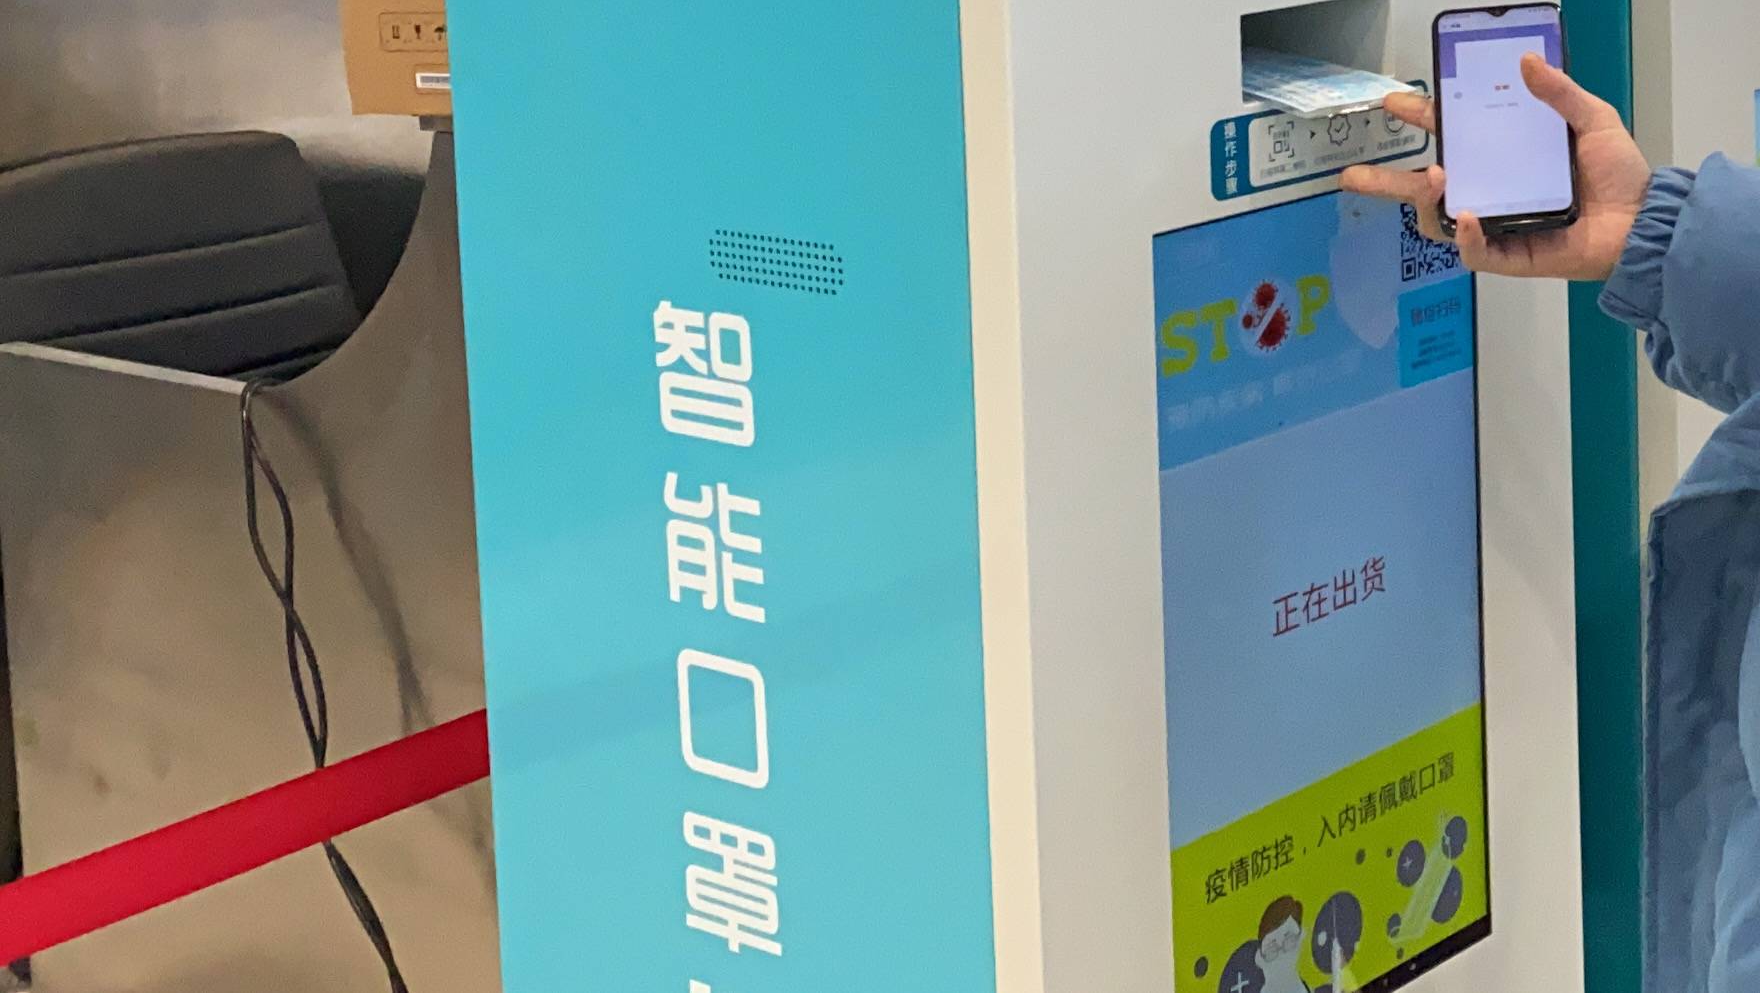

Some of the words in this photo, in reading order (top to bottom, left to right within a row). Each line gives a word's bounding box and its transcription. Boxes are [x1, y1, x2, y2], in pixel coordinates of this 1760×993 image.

[653, 300, 783, 993] 智能口罩
[1272, 555, 1387, 637] 正在出货
[1205, 751, 1455, 904] 疫情防控，入内请佩戴口罩
